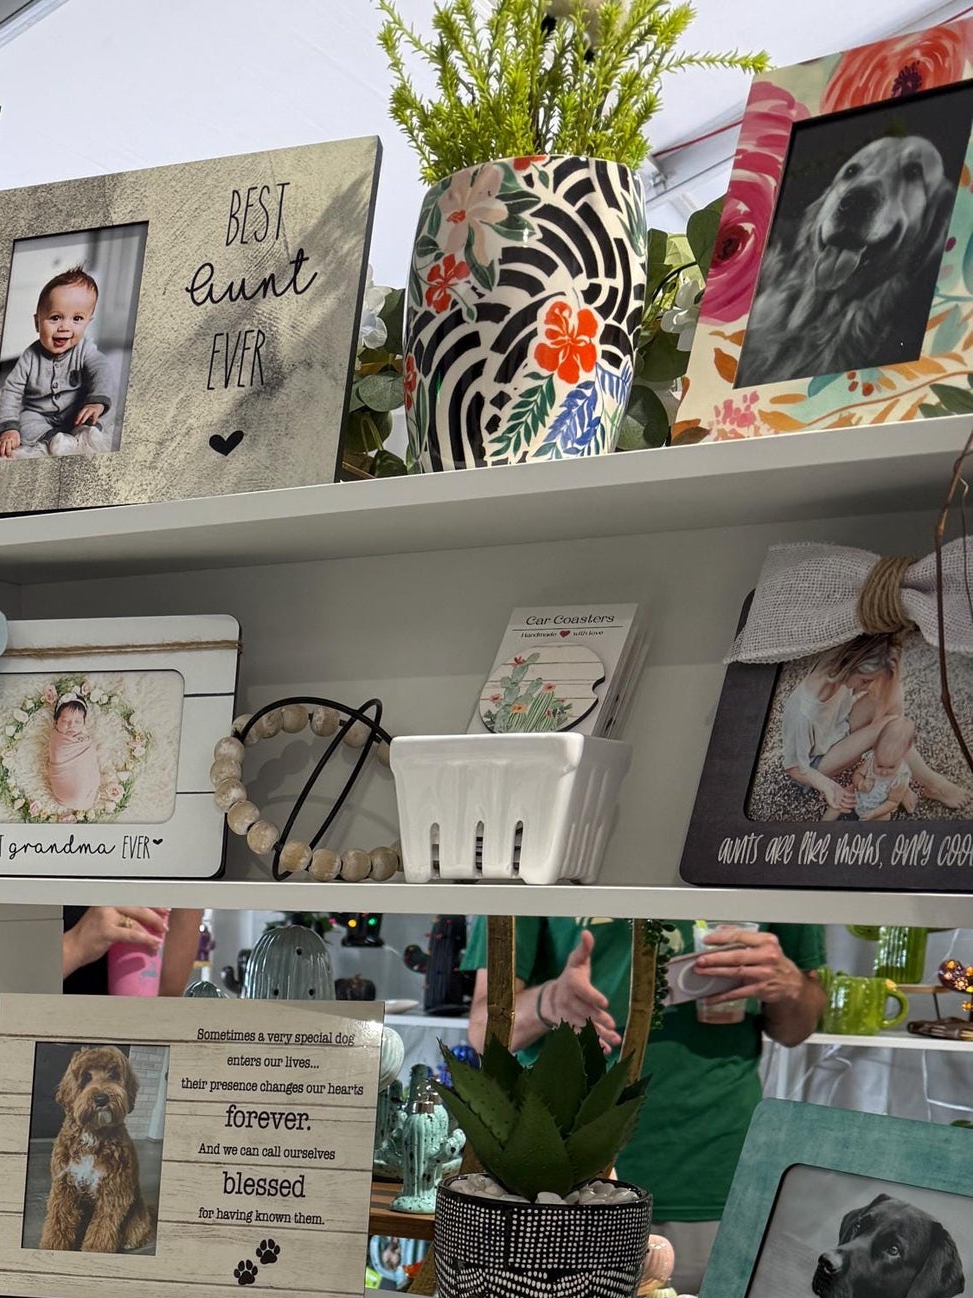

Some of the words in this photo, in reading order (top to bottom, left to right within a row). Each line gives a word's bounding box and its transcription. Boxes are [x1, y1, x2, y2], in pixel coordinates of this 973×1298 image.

[225, 182, 290, 246] BEST
[207, 329, 266, 390] EVER
[526, 616, 551, 626] Car
[553, 614, 615, 625] Coasters
[9, 834, 115, 860] grandma
[121, 835, 151, 859] EVER
[717, 832, 765, 866] aunts
[765, 833, 797, 866] are
[798, 830, 831, 866] like
[197, 1028, 255, 1042] Sometimes
[257, 1032, 265, 1042] a
[267, 1032, 292, 1046] very
[294, 1032, 333, 1046] special
[335, 1032, 355, 1047] dog
[227, 1056, 261, 1067] enters
[263, 1057, 283, 1068] our
[285, 1056, 320, 1070] lives...
[181, 1078, 207, 1090] their
[209, 1080, 257, 1094] presence
[259, 1079, 304, 1096] changes
[307, 1084, 327, 1094] our
[327, 1082, 364, 1096] hearts
[224, 1104, 311, 1131] forever.
[197, 1142, 221, 1156] And
[223, 1146, 238, 1156] we
[239, 1147, 259, 1157] can
[261, 1146, 281, 1158] call
[283, 1147, 336, 1160] ourselves
[223, 1170, 306, 1198] blessed
[198, 1207, 215, 1220] for
[216, 1208, 253, 1223] having
[255, 1209, 292, 1224] known
[293, 1212, 325, 1226] them.
